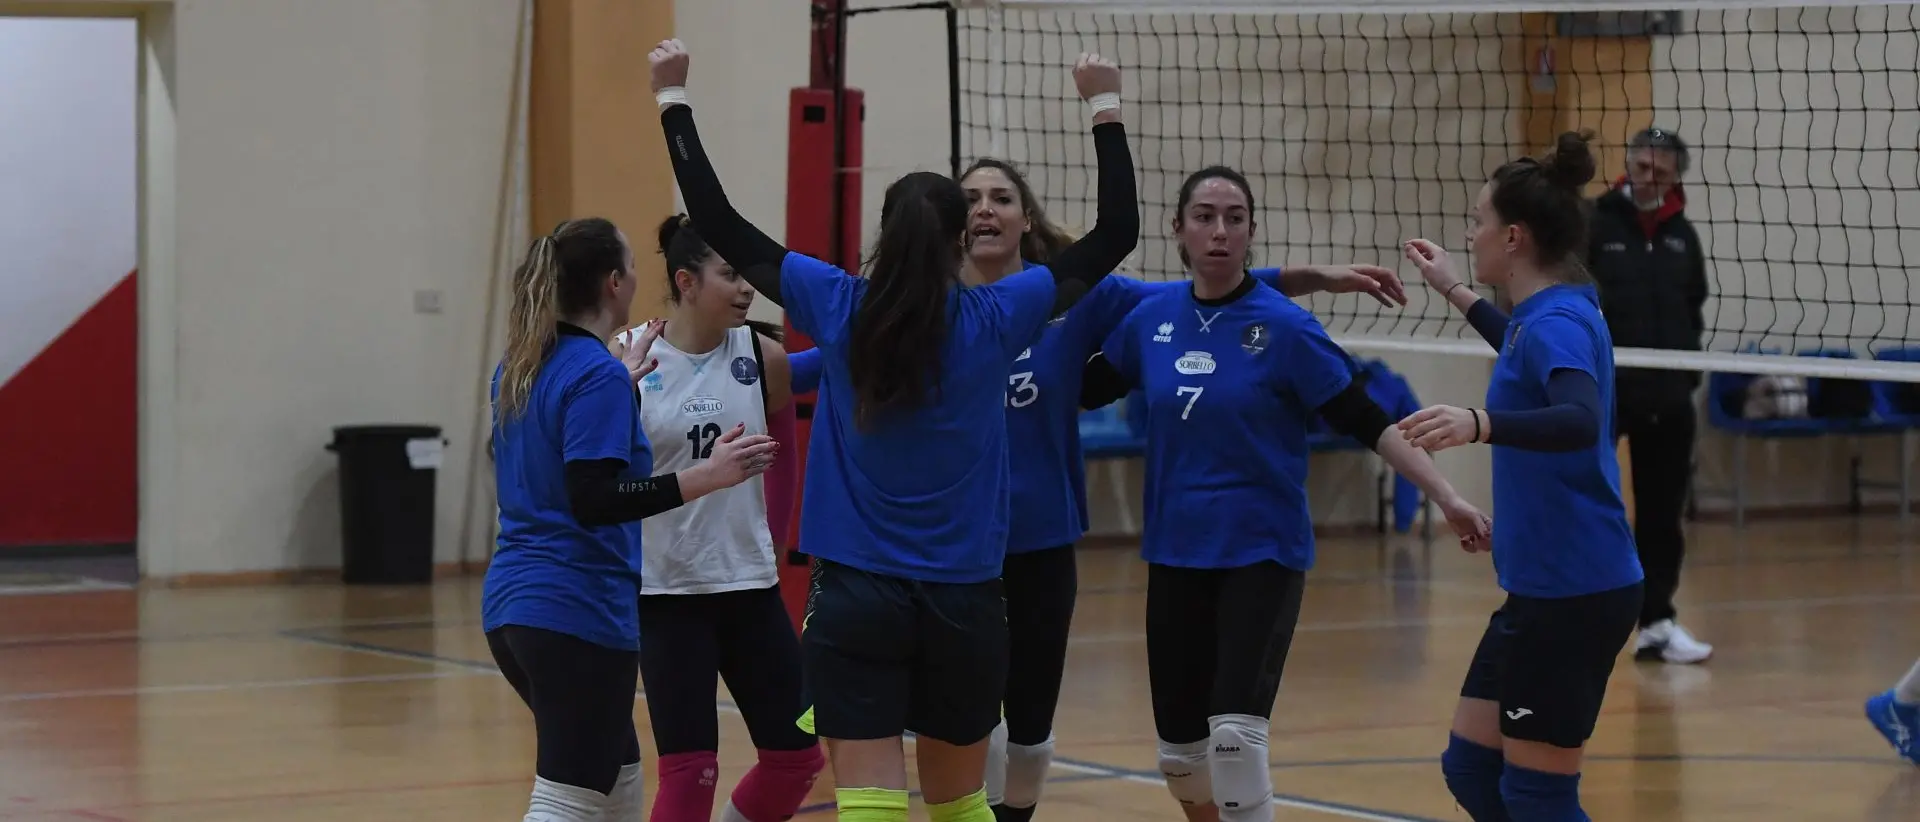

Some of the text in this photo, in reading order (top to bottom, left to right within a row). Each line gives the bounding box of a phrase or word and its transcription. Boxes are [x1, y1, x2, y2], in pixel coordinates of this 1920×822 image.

[1179, 360, 1214, 370] SORBELLO
[683, 402, 723, 413] SORBELLO
[1176, 386, 1204, 420] 7
[686, 422, 722, 460] 12
[618, 482, 658, 493] KIPSTA
